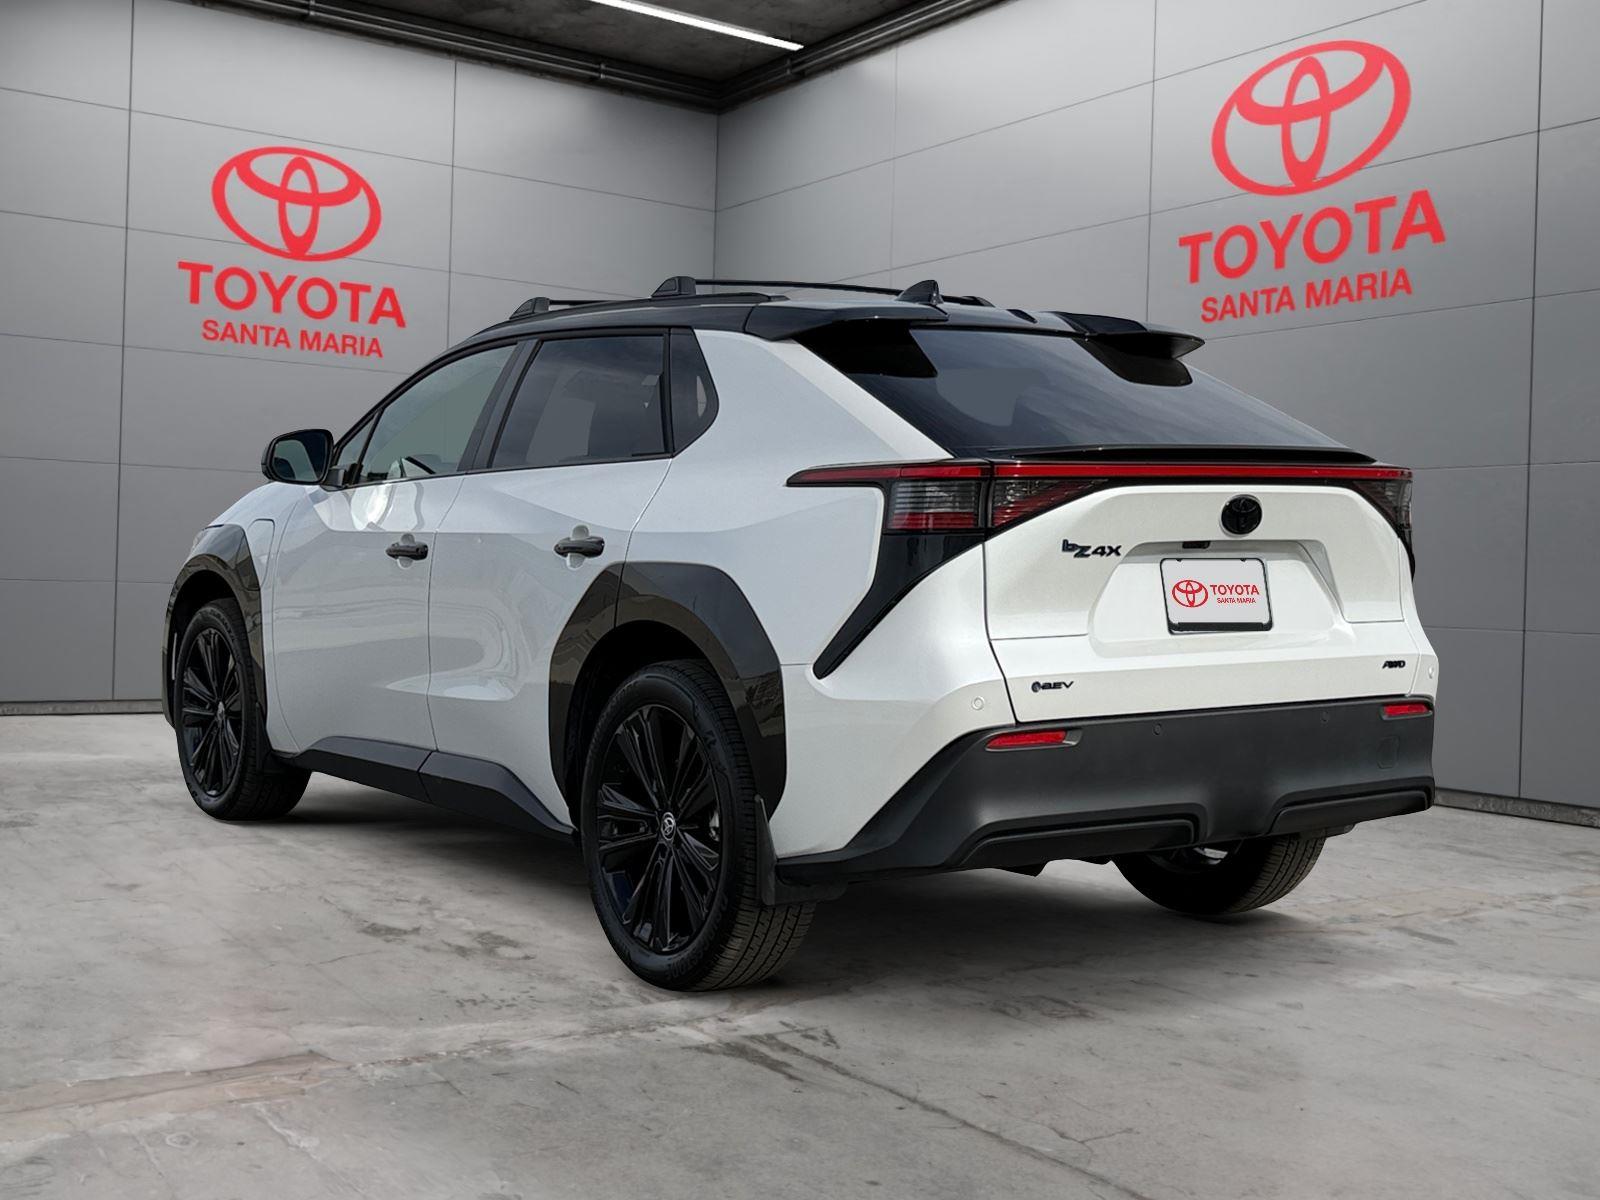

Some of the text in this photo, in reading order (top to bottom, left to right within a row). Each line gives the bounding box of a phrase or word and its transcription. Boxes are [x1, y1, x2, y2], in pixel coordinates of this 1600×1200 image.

[1178, 189, 1446, 285] TOYOTA
[177, 260, 407, 329] TOYOTA
[1200, 267, 1413, 324] SANTA MARIA
[201, 319, 384, 358] SANTA MARIA
[1061, 538, 1122, 558] bZ4X
[1210, 584, 1260, 596] TOYOTA
